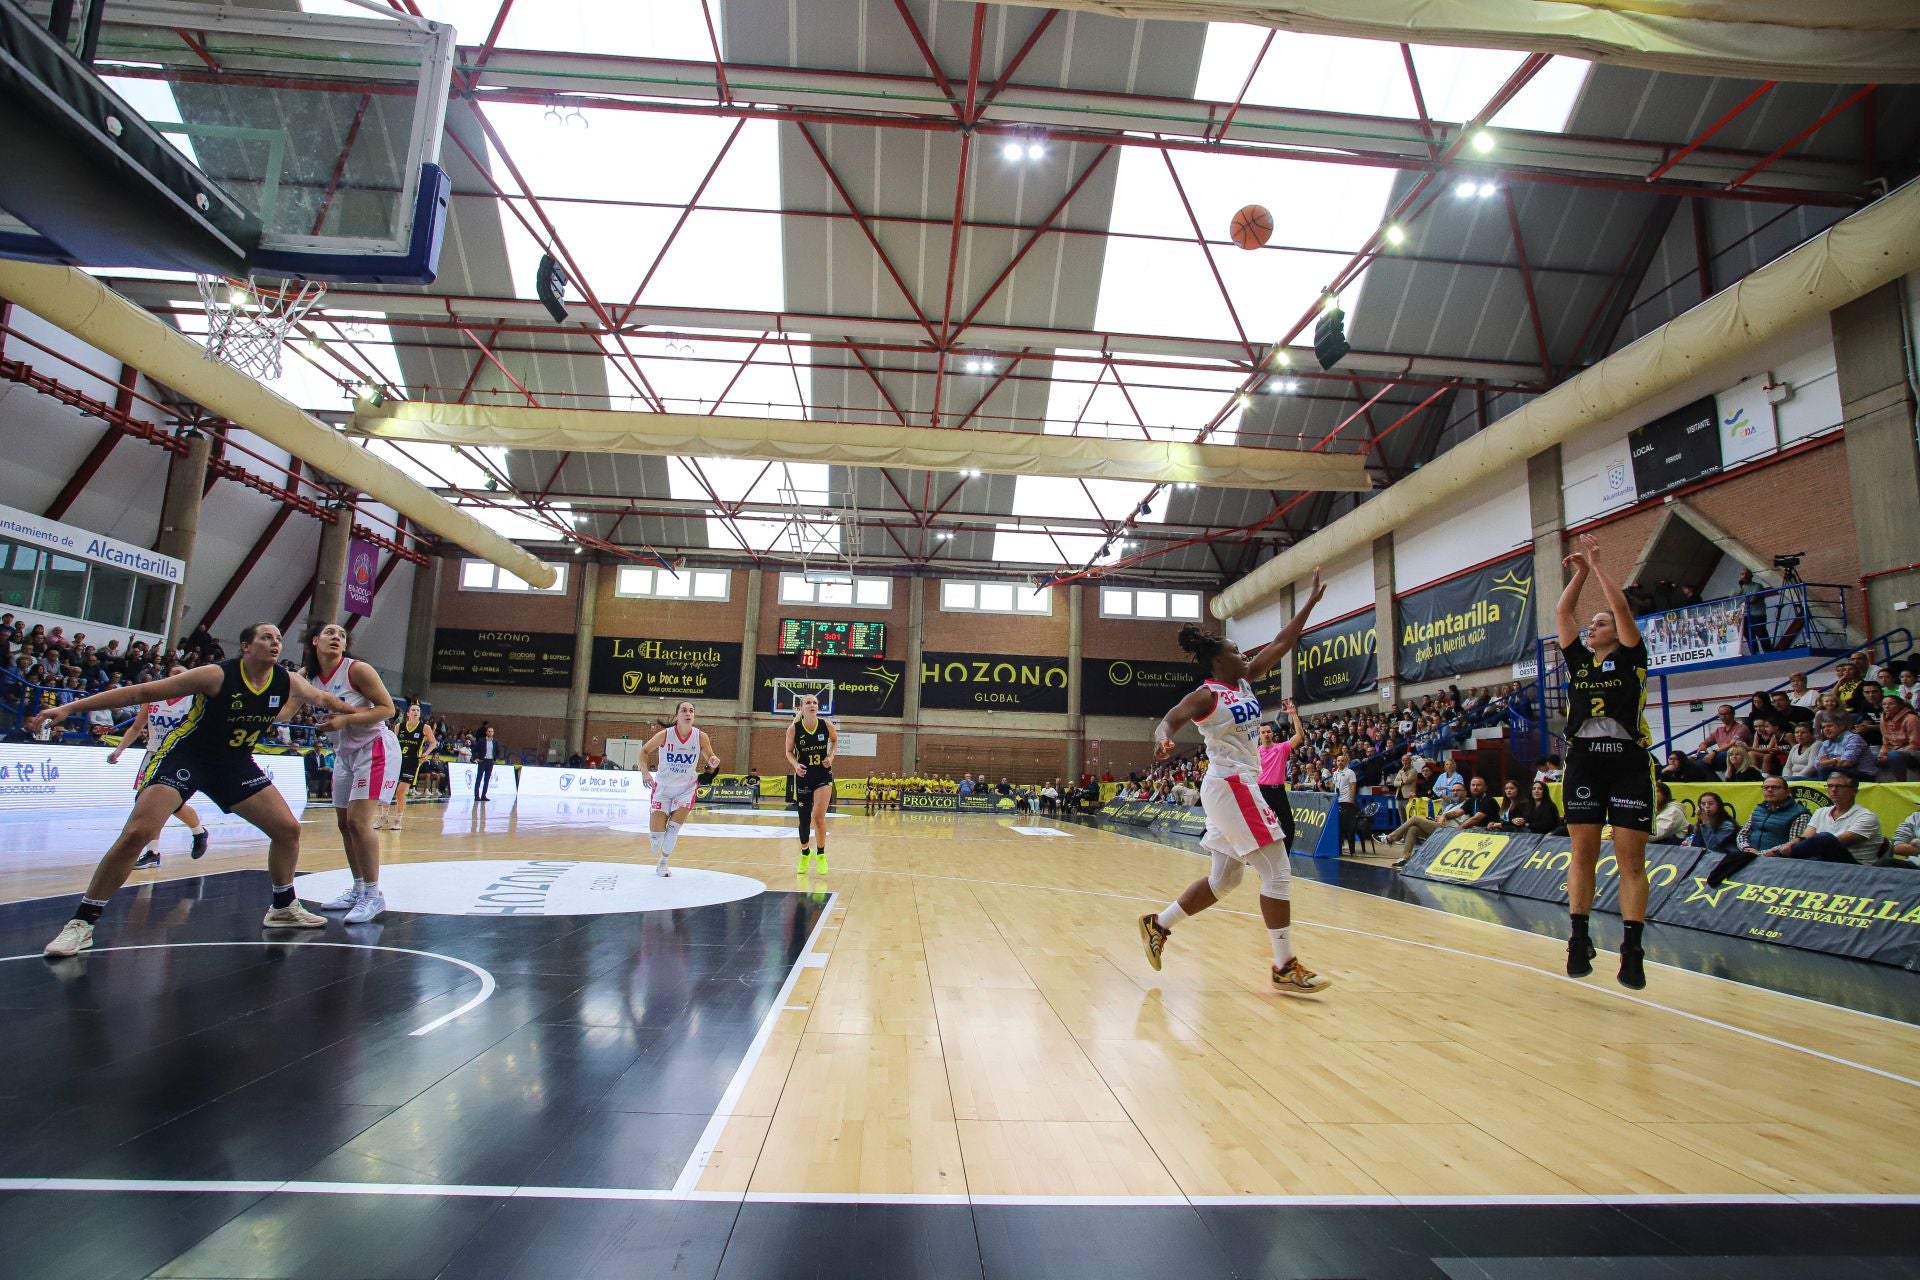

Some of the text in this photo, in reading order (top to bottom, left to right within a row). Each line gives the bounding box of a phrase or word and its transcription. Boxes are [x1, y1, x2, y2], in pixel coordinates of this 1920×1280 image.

[1686, 418, 1711, 435] VISITANTE
[1633, 443, 1655, 458] LOCAL
[61, 536, 74, 547] de
[86, 539, 177, 578] Alcantarilla
[1402, 600, 1500, 646] Alcantarilla
[479, 632, 530, 643] HOZONO
[1434, 642, 1441, 656] la
[1442, 633, 1467, 655] huerta
[1467, 628, 1486, 645] nace
[612, 639, 721, 662] La Hacienda
[1297, 628, 1377, 675] HOZONO
[1655, 654, 1667, 666] LF
[1670, 648, 1714, 664] ENDESA
[647, 673, 656, 684] la
[660, 671, 679, 685] boca
[682, 674, 692, 686] te
[921, 662, 1068, 689] HOZONO
[1137, 671, 1194, 681] Costa Cálida
[1323, 671, 1350, 687] GLOBAL
[1519, 667, 1536, 675] OESTE
[764, 679, 821, 690] Alantarilla
[838, 682, 880, 692] deporte
[974, 692, 1020, 703] GLOBAL
[1220, 691, 1239, 705] 32
[1590, 697, 1605, 717] 2
[229, 729, 261, 747] 34
[667, 743, 674, 752] 11
[1588, 742, 1623, 752] JAIRIS
[666, 752, 697, 764] BAXI
[808, 754, 821, 766] 13
[15, 761, 34, 782] te
[40, 757, 60, 782] lía
[579, 775, 630, 787] la boca te lía
[902, 796, 952, 807] PROYCO
[1439, 848, 1491, 870] CRC
[1523, 850, 1678, 887] HOOO
[1736, 883, 1920, 924] ESTRELLA
[1765, 905, 1873, 928] DE LEVANTE
